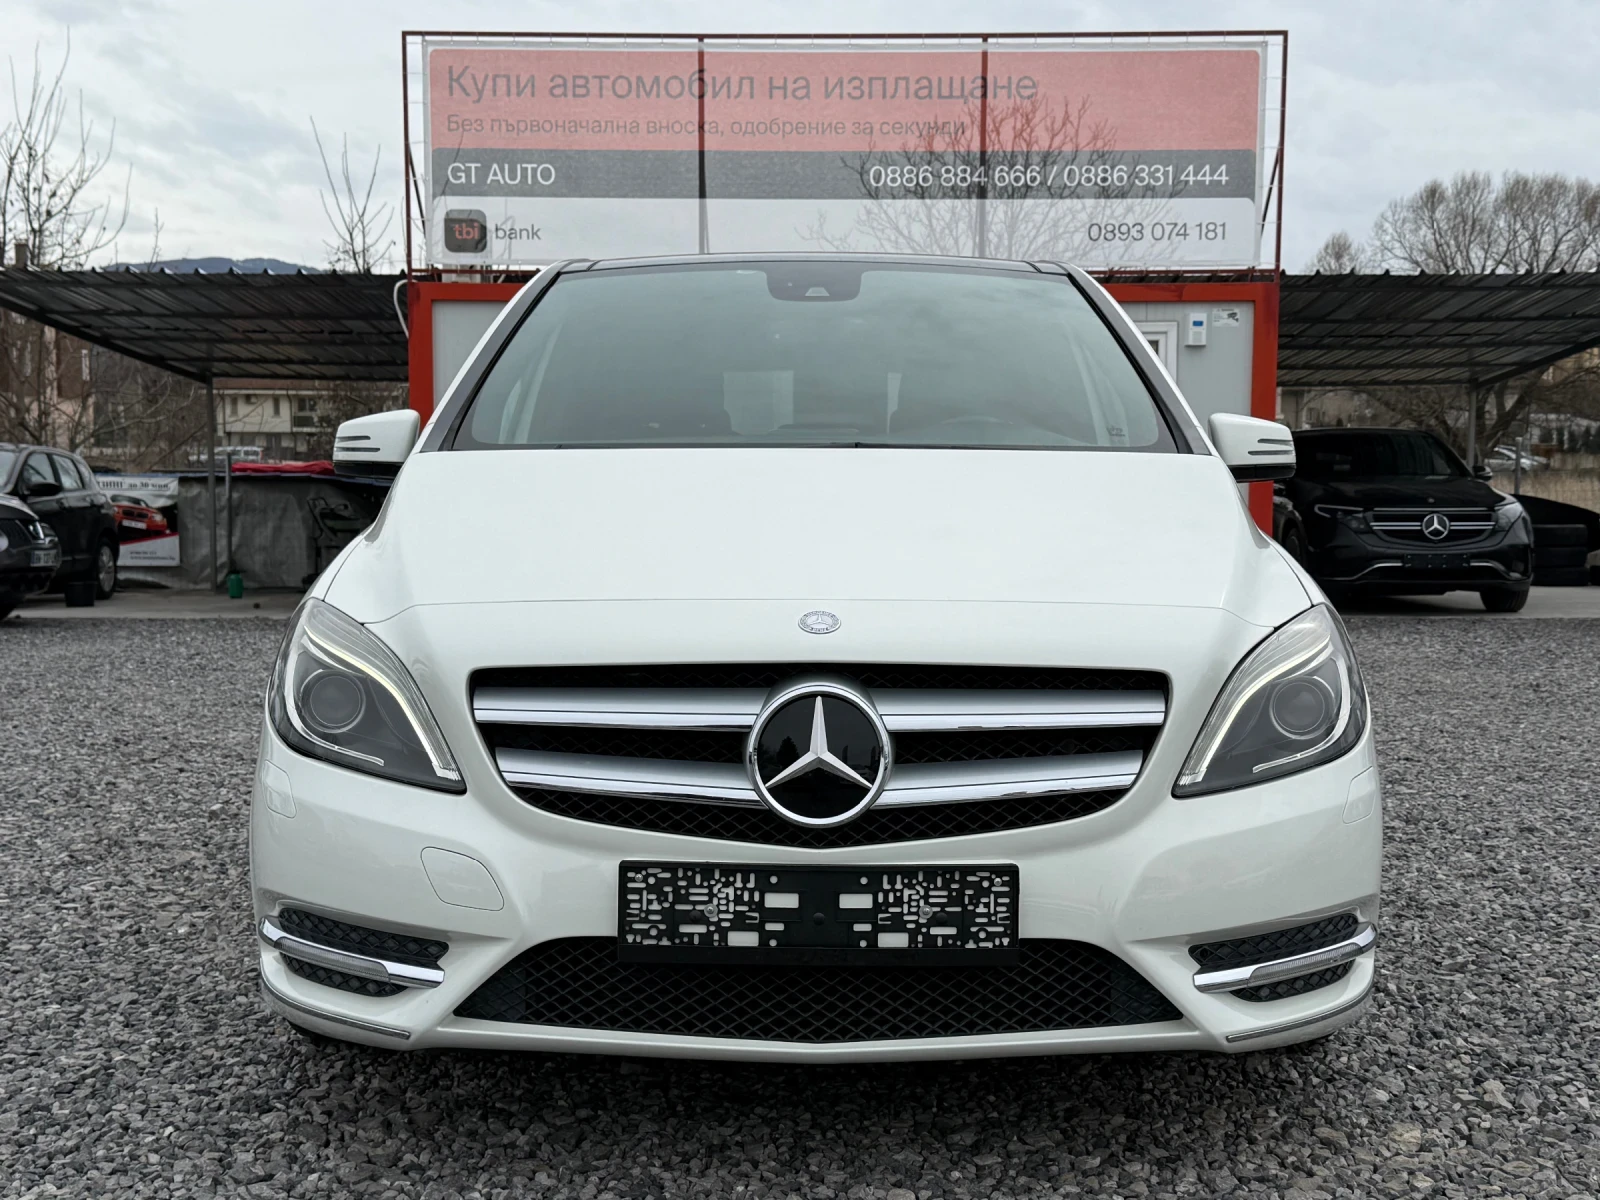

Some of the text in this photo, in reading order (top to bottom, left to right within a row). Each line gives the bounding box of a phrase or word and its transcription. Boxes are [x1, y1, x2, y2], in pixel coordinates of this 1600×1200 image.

[447, 65, 1038, 105] Купи автомобил на изплащане
[447, 114, 966, 140] Без първоначална вноска, одобрение за секунди
[447, 163, 556, 186] GT AUTO
[869, 165, 934, 187] 0886
[940, 165, 988, 187] 884
[994, 165, 1041, 187] 666
[1063, 164, 1128, 187] 0886
[1134, 164, 1175, 186] 331
[1180, 164, 1230, 186] 444
[453, 223, 542, 241] tbi bank
[1087, 221, 1227, 242] 0893 074 181
